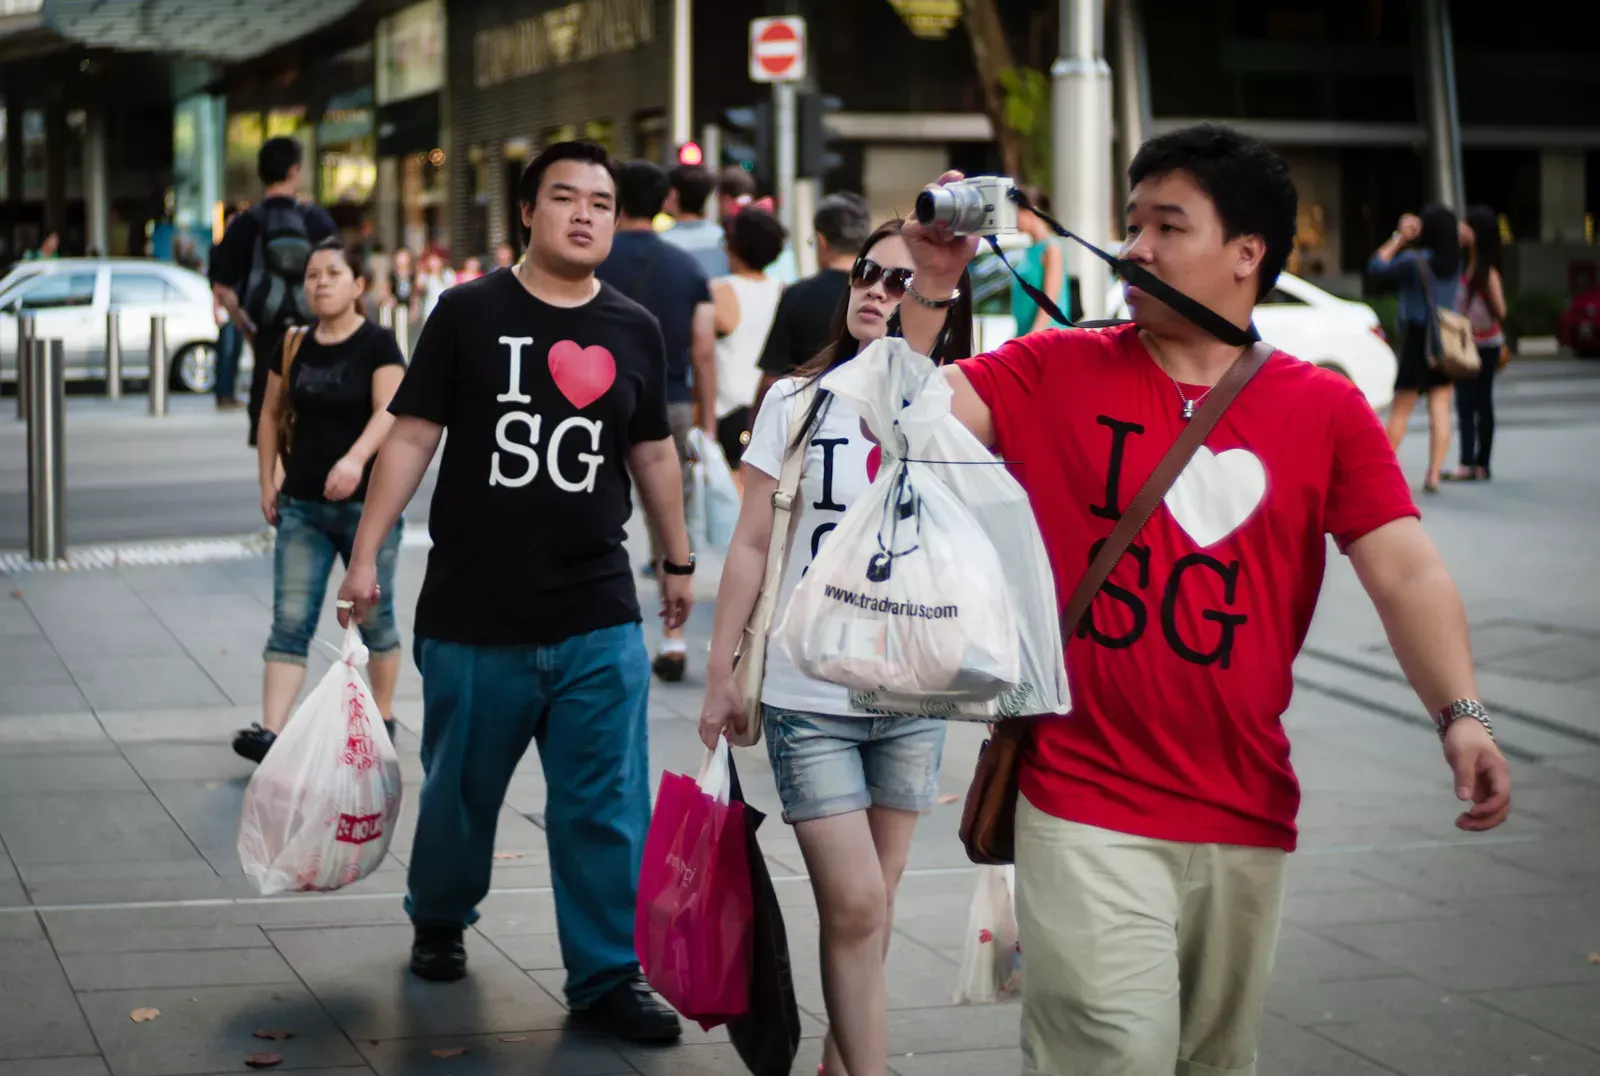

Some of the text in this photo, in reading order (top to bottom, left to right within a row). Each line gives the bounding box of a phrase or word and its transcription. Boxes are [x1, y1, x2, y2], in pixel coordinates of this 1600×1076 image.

[496, 335, 534, 404] I
[489, 411, 605, 494] SG
[810, 437, 849, 512] I
[1089, 414, 1145, 520] I
[1076, 537, 1247, 671] SG
